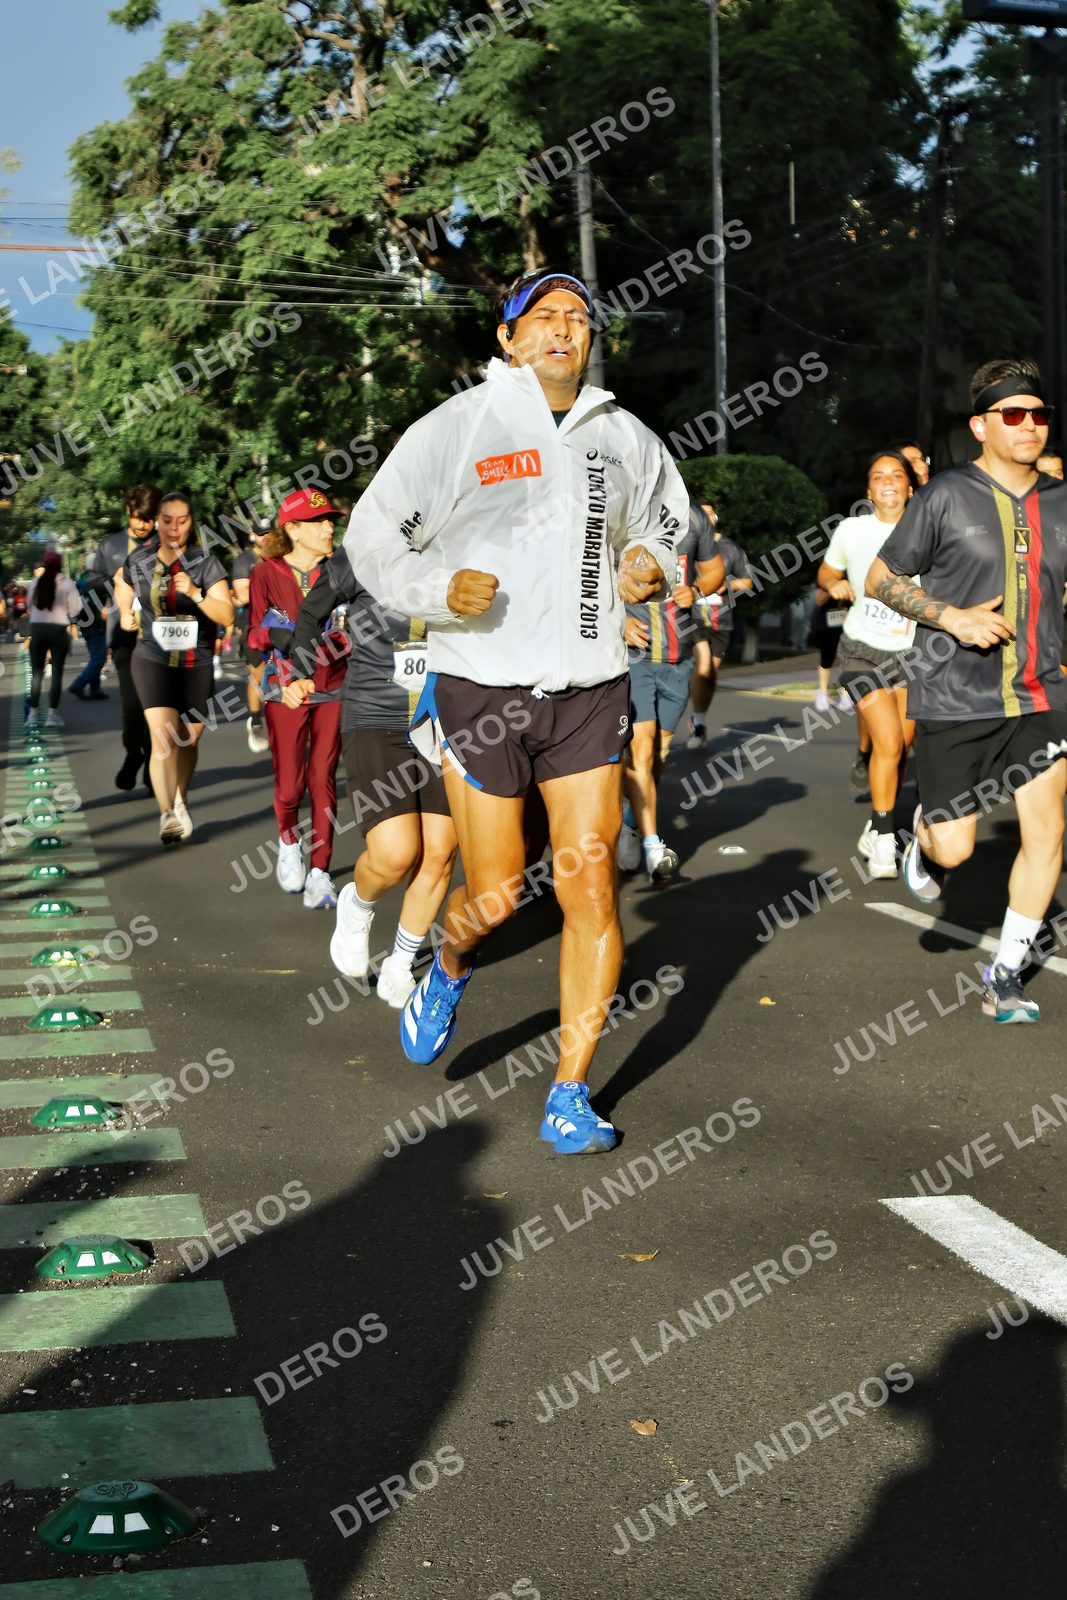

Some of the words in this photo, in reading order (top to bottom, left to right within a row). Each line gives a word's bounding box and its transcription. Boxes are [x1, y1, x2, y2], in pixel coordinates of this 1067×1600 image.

[600, 453, 623, 466] asic
[587, 466, 607, 513] TOKYO
[580, 517, 606, 600] MARATHON
[161, 626, 190, 638] 7906
[580, 604, 599, 640] 2013
